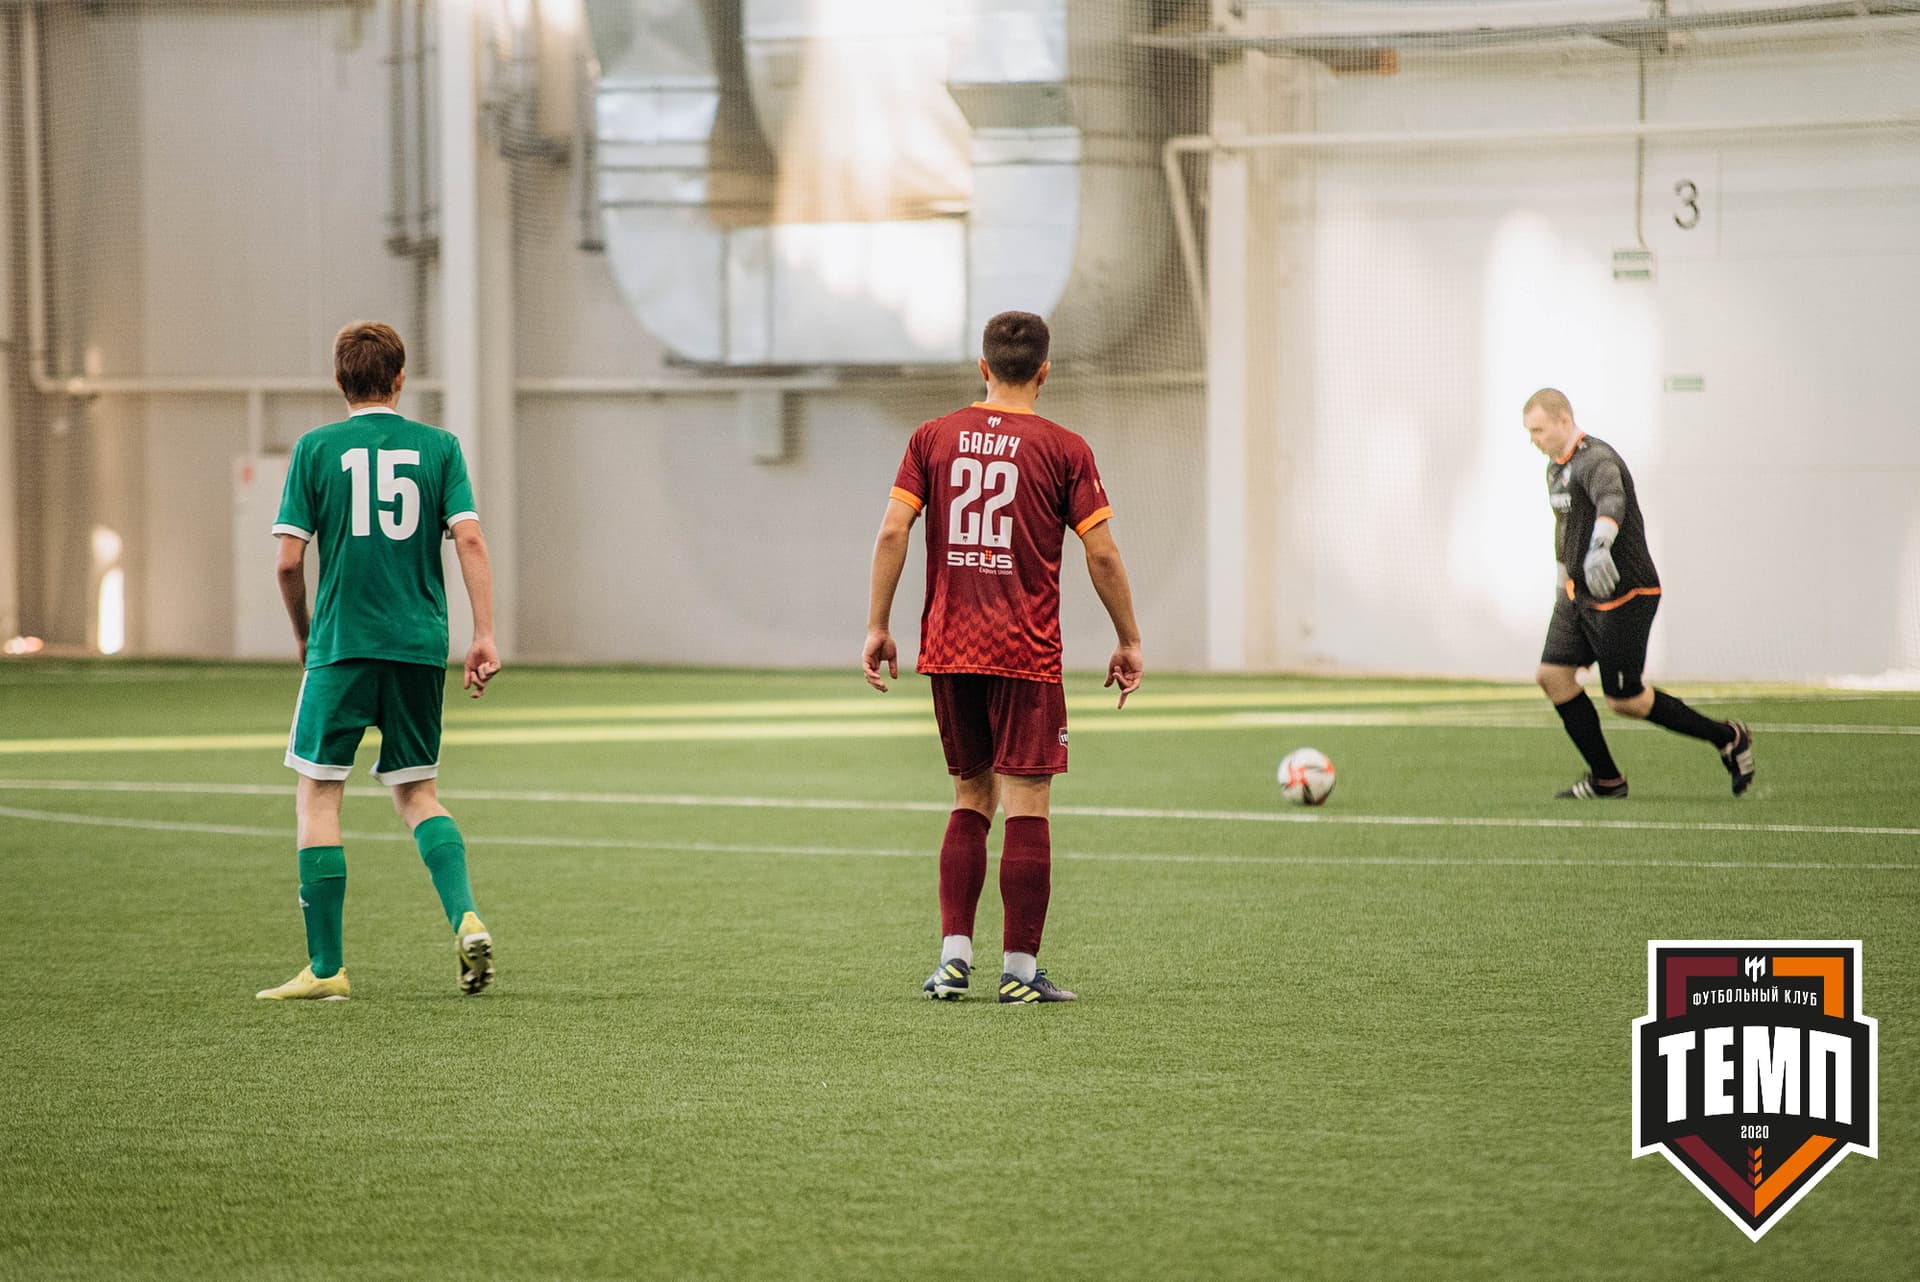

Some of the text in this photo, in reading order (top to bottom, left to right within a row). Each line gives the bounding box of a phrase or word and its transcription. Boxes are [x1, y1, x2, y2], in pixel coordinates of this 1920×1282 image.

[1674, 179, 1699, 230] 3
[958, 430, 1021, 459] БАБИЧ
[340, 447, 421, 541] 15
[948, 458, 1019, 548] 22
